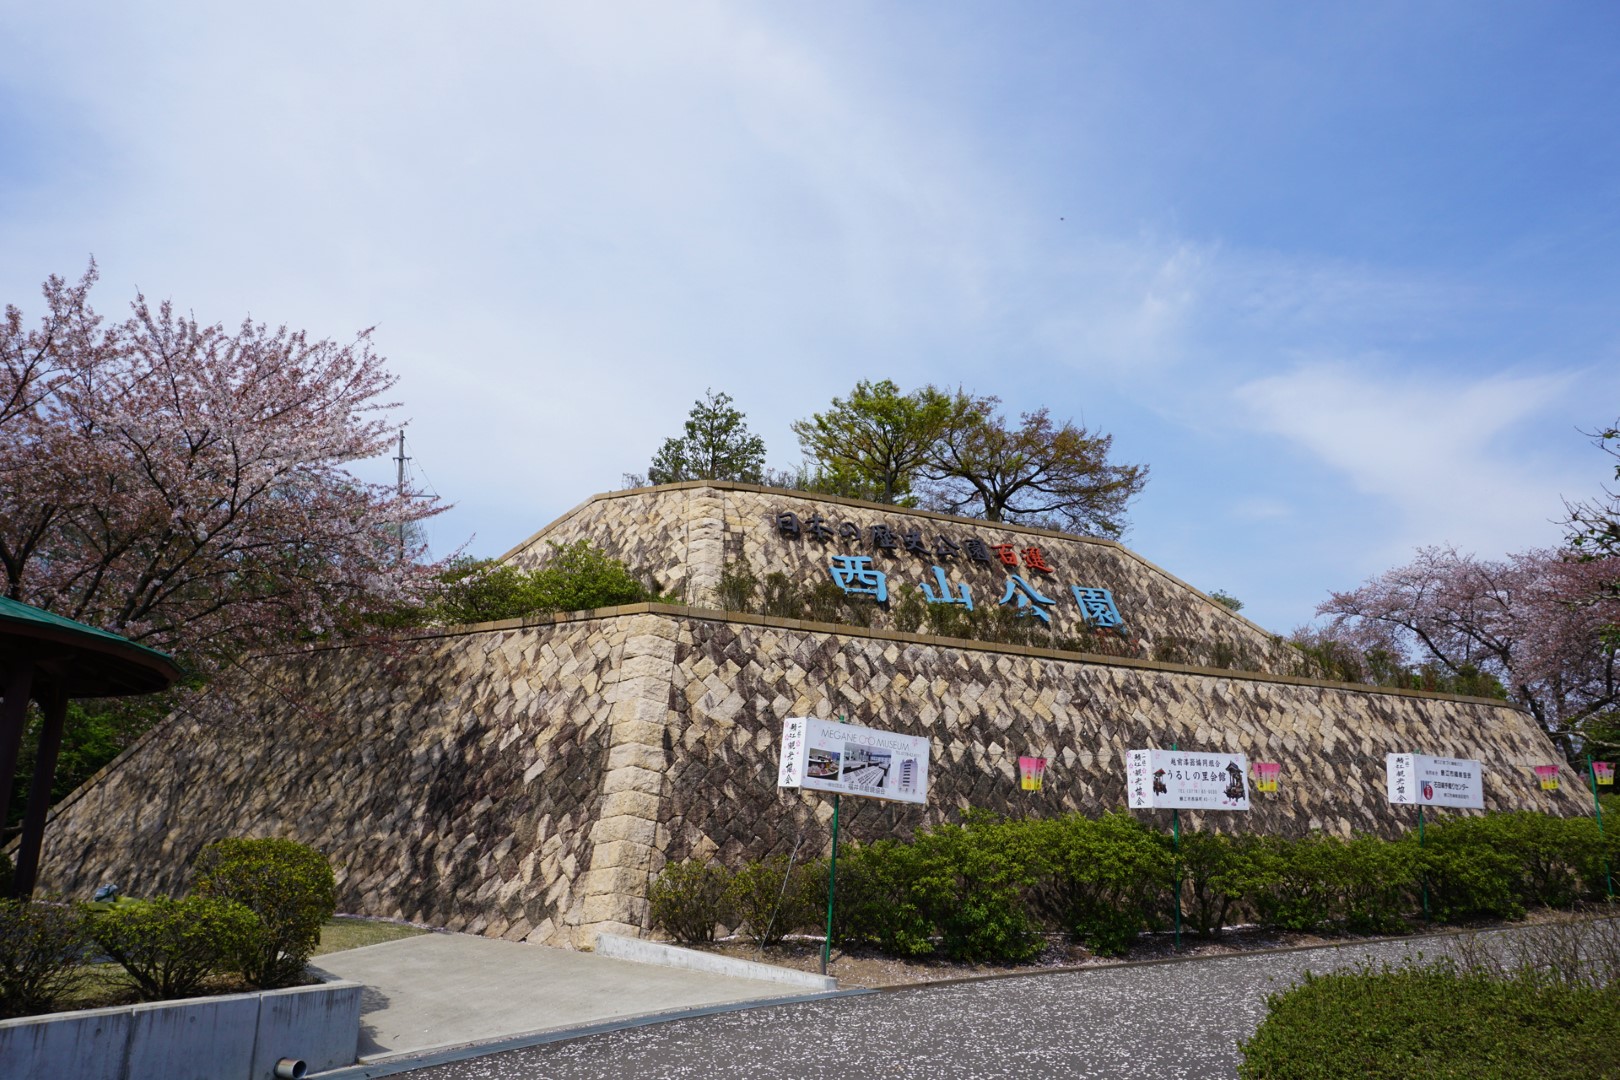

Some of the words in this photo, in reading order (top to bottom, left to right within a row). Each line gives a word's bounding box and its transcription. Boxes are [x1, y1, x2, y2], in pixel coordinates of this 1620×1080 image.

[829, 555, 1127, 634] 西山公園
[821, 729, 857, 741] MEGANE
[877, 738, 910, 751] MUSEUM
[1167, 769, 1227, 782] うるしの里会館
